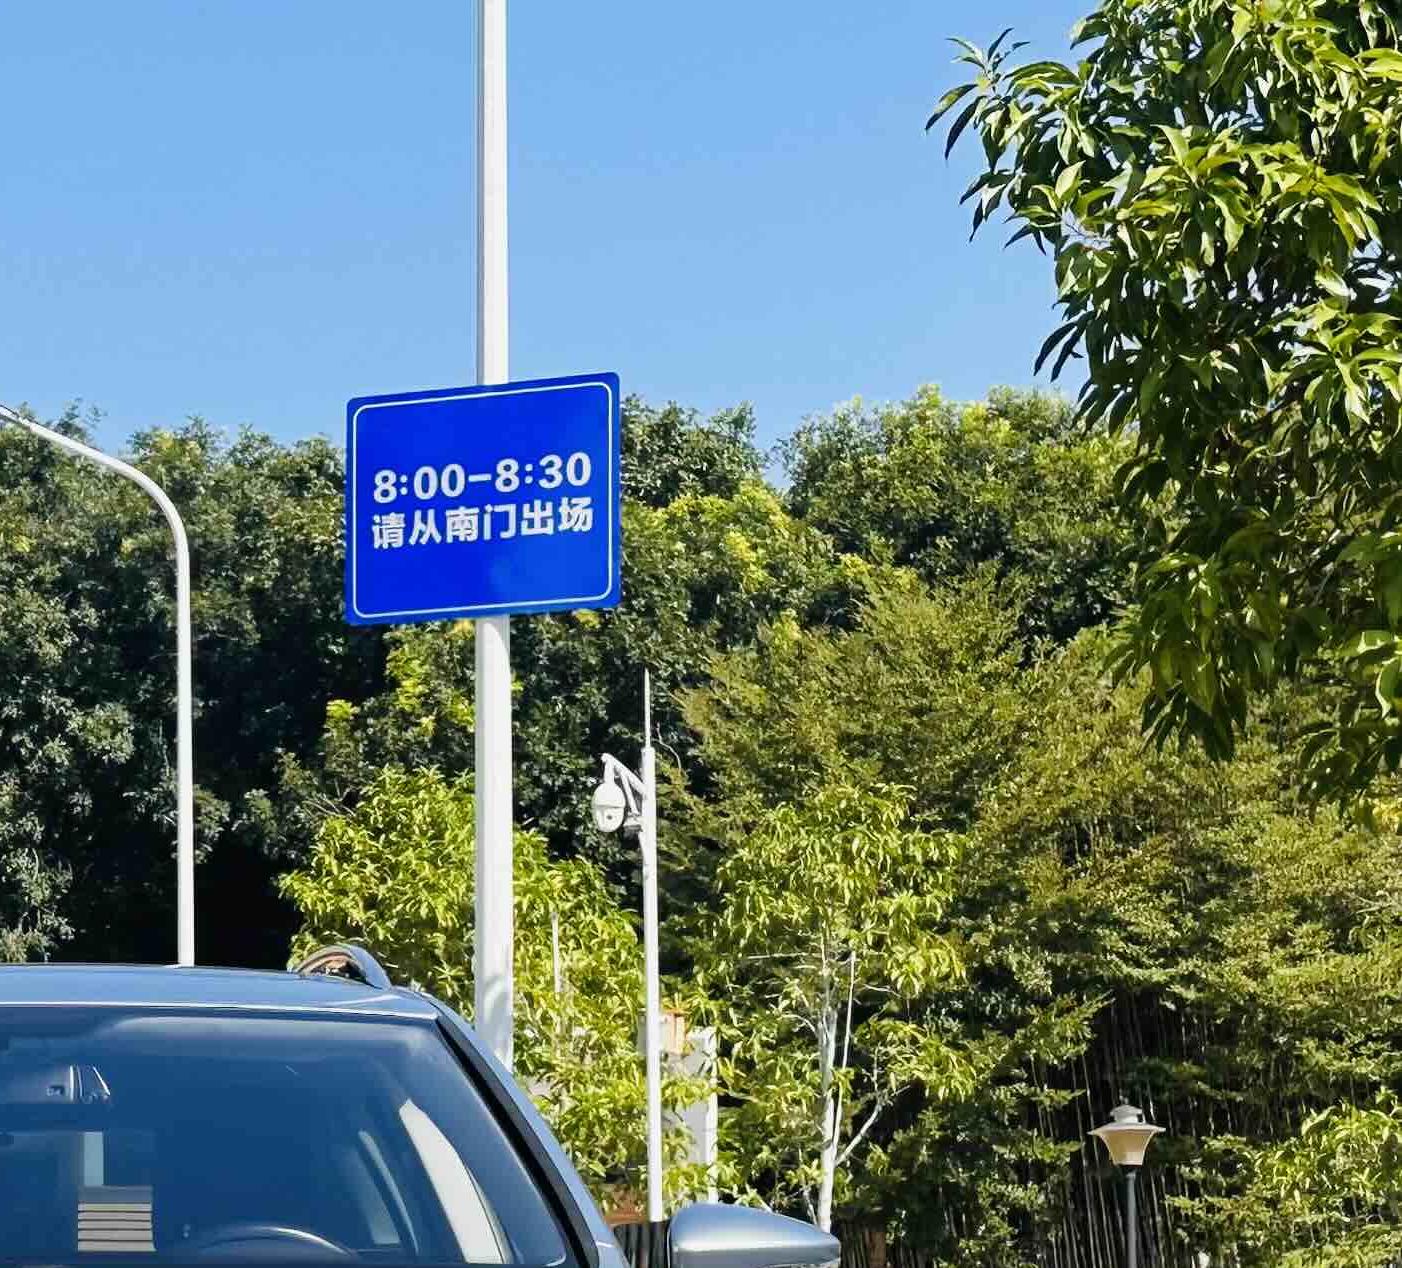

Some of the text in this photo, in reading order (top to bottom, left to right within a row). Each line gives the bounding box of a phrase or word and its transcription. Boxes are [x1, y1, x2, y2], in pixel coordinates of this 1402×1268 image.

[373, 452, 592, 504] 8:00-8:30
[371, 497, 594, 549] 请从南门出场
